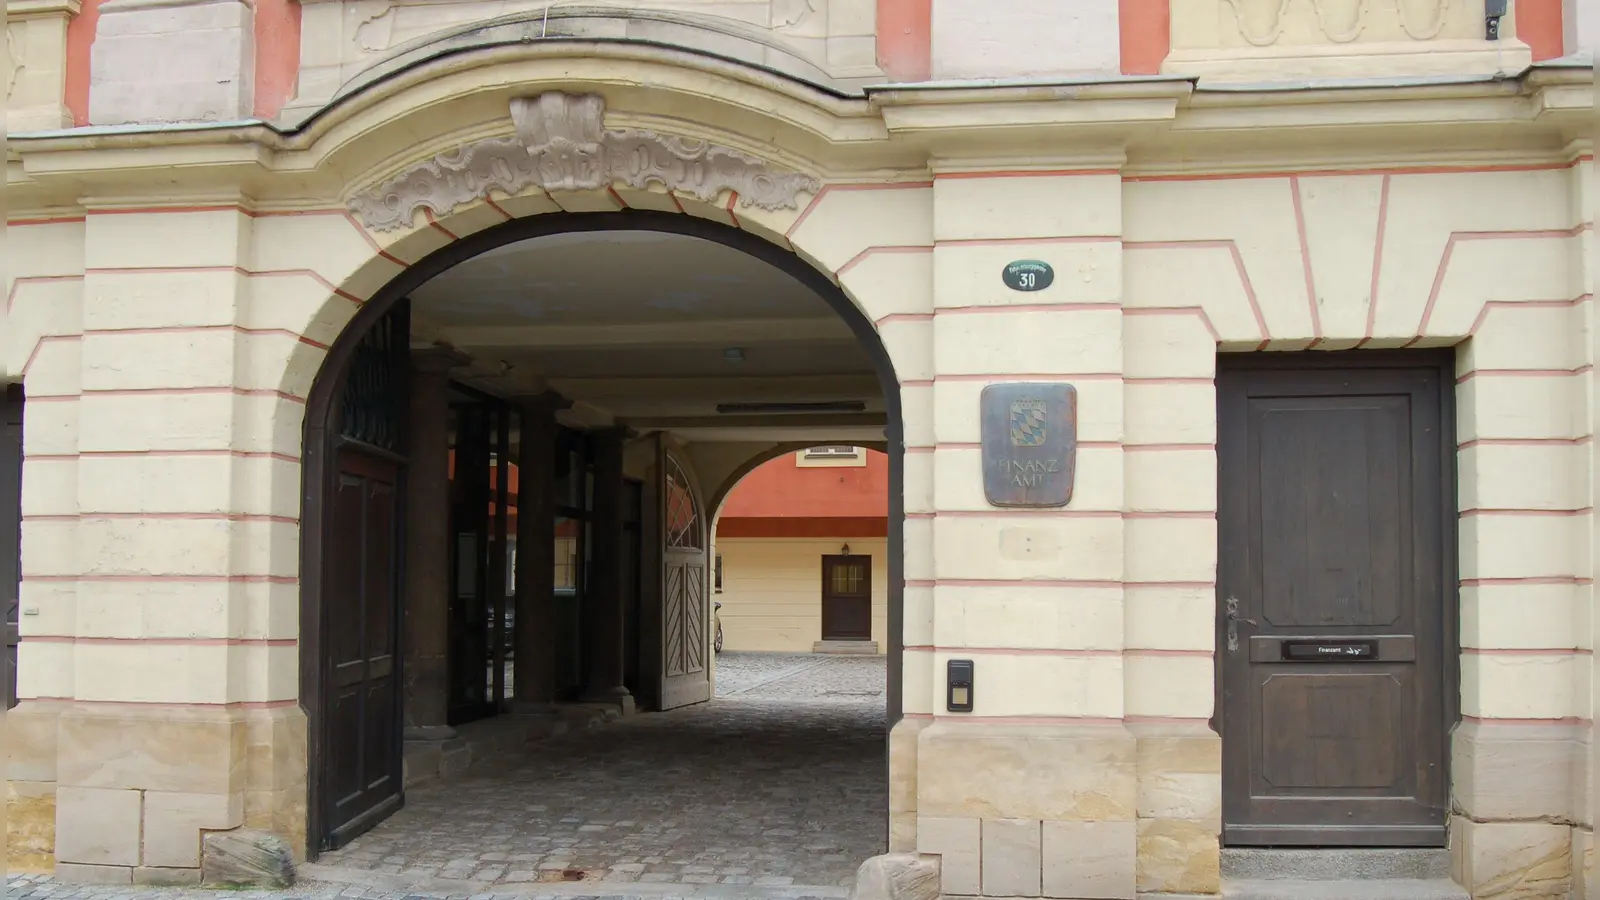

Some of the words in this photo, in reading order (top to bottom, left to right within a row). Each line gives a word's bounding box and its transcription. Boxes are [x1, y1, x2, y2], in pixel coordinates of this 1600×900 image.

[1019, 272, 1036, 287] 30
[998, 459, 1059, 473] FINANZ
[1011, 474, 1045, 487] AMT
